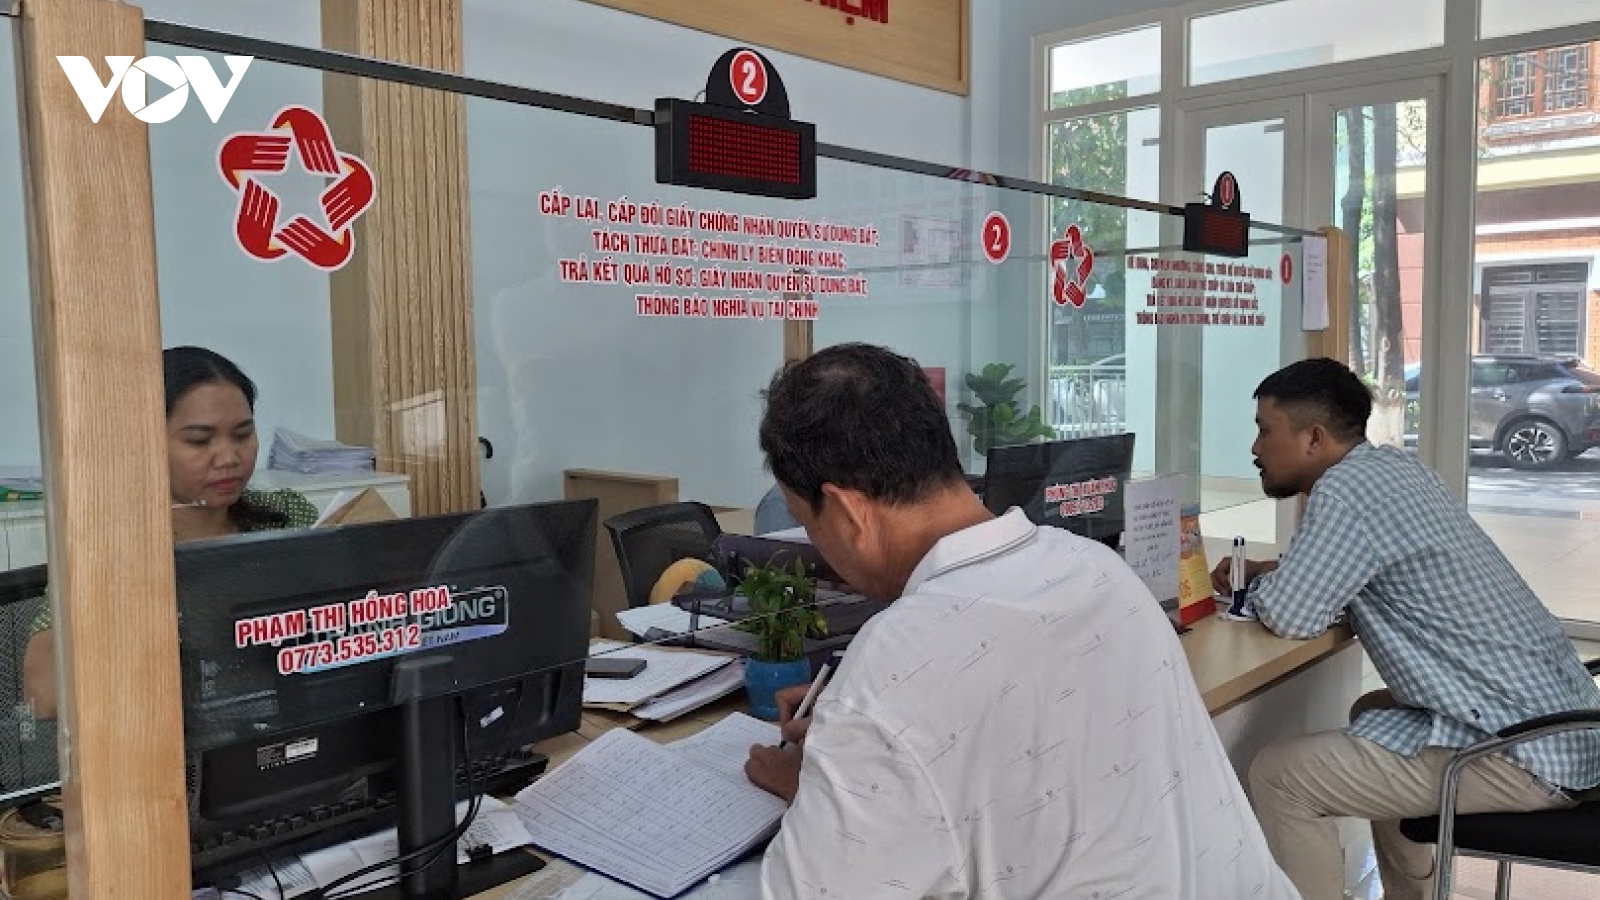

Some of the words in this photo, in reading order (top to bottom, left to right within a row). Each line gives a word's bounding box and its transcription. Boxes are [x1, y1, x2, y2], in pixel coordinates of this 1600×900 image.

[741, 60, 757, 96] 2
[540, 186, 571, 215] CẤP
[608, 196, 636, 224] CẤP
[666, 201, 695, 228] GIẤY
[593, 227, 630, 254] TÁCH
[559, 253, 588, 282] TRẢ
[592, 255, 619, 282] KẾT
[624, 259, 651, 285] QUẢ
[701, 263, 727, 288] GIẤY
[731, 268, 762, 293] NHẬN
[636, 289, 680, 316] THÔNG
[683, 291, 709, 316] BÁO
[237, 611, 306, 646] PHẠM
[311, 603, 345, 631] THỊ
[351, 590, 407, 623] HỒNG
[412, 587, 449, 613] HOA
[279, 626, 420, 673] 0773.535.312
